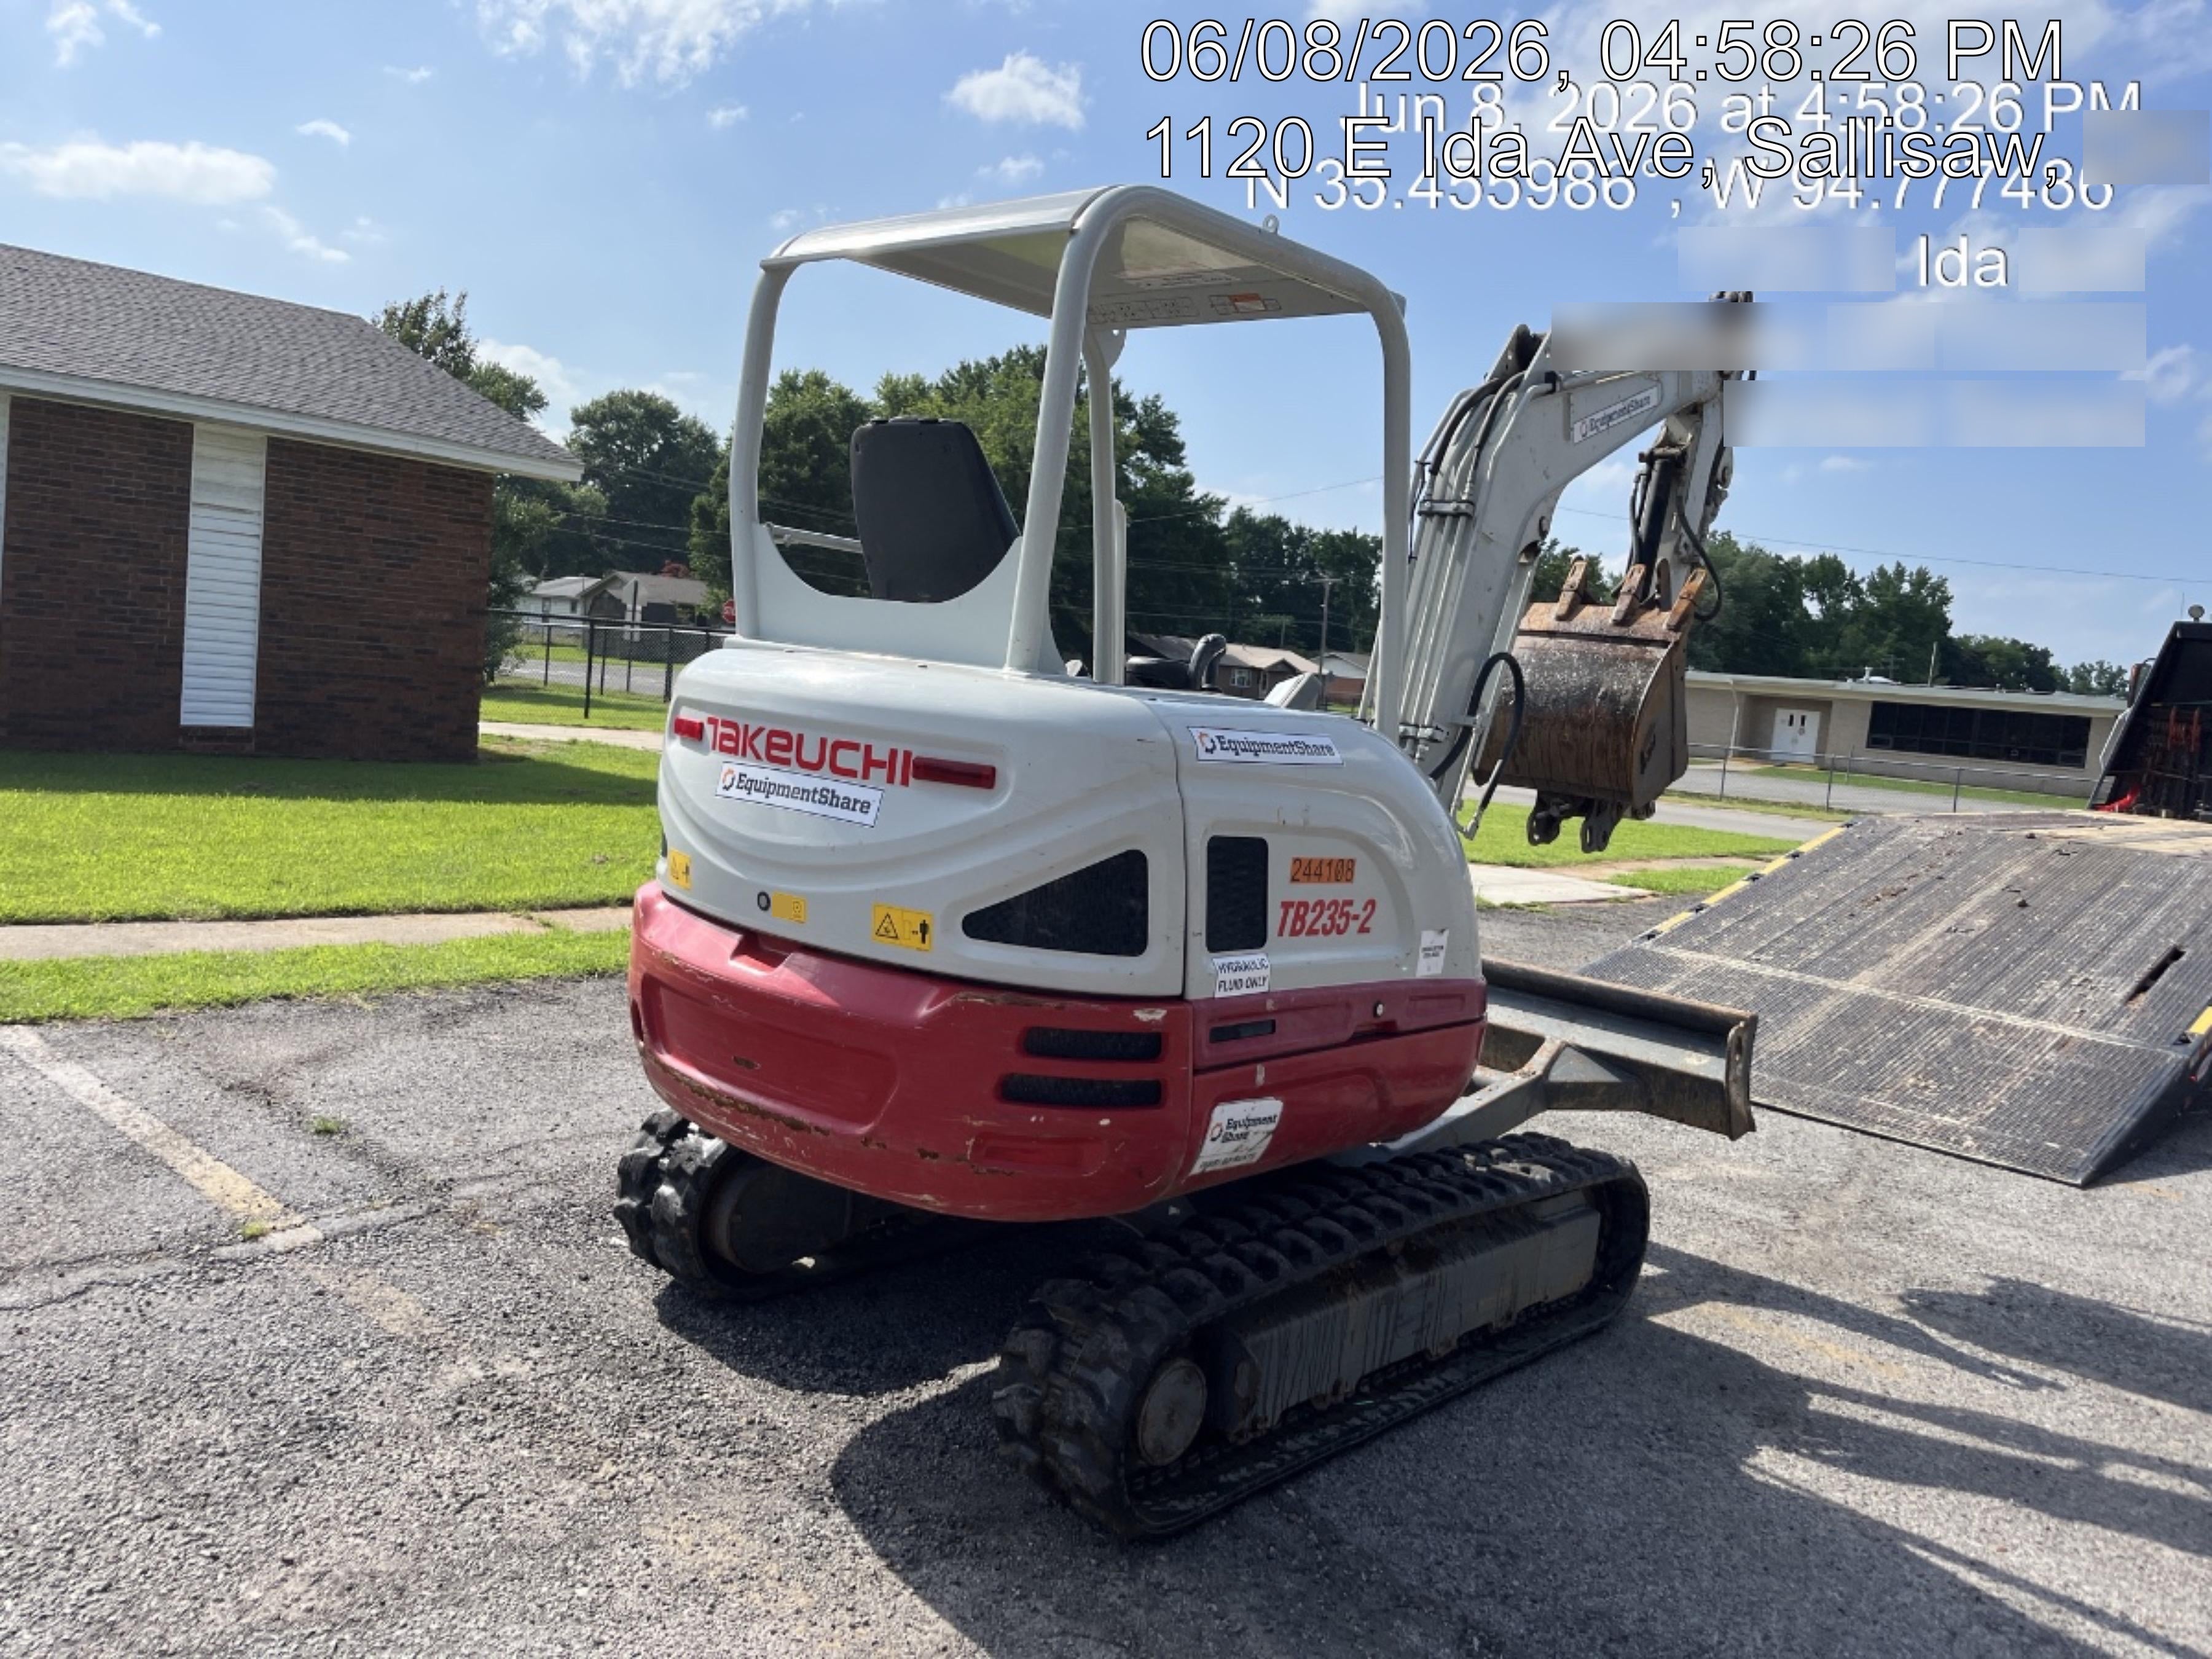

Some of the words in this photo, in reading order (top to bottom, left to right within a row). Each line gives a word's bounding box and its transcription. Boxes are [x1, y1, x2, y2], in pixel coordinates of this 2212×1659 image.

[1215, 735, 1335, 756] EquipmentShare
[736, 772, 871, 814] EquipmentShare
[1291, 858, 1354, 882] 244108
[1277, 898, 1376, 937] TB235-2
